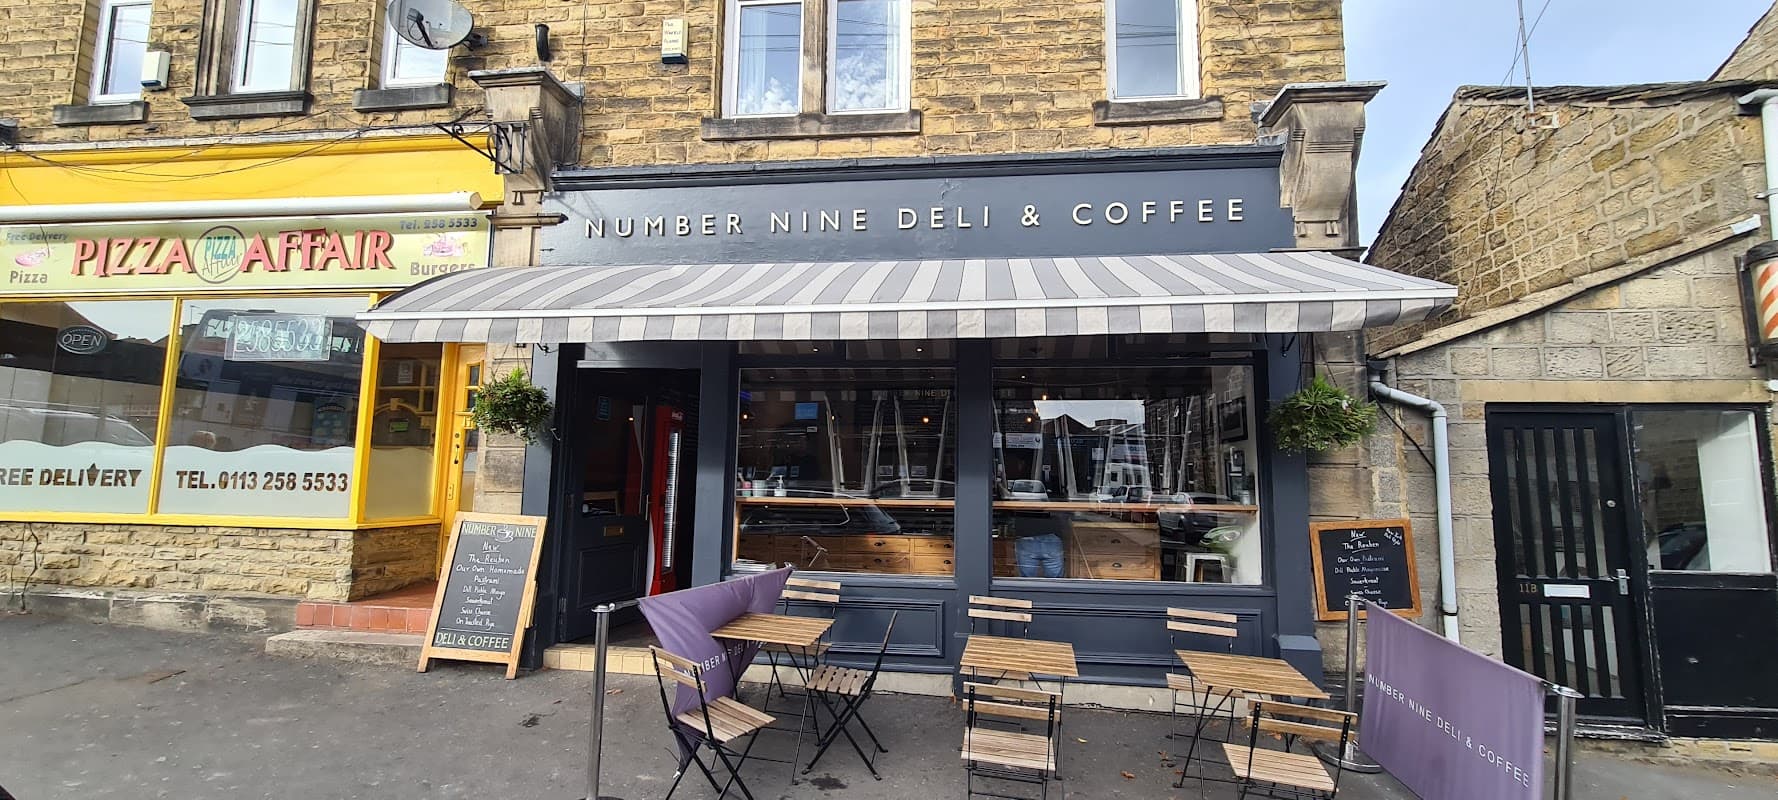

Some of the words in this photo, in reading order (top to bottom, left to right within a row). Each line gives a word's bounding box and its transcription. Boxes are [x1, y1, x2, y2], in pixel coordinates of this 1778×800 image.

[400, 220, 420, 230] Tel.
[424, 219, 446, 229] 258
[448, 217, 478, 228] 5533
[584, 213, 743, 238] NUMBER
[769, 208, 868, 233] NINE
[898, 205, 990, 230] DELI
[1020, 203, 1041, 228] &
[1071, 198, 1245, 226] COFFEE
[6, 232, 26, 241] Free
[29, 231, 68, 242] Delivery
[71, 236, 196, 277] PIZZA
[239, 227, 397, 272] AFFAIR
[204, 236, 236, 259] PIZZA
[10, 270, 48, 284] Pizza
[62, 333, 103, 347] OPEN
[39, 464, 142, 487] DELIVERY
[262, 472, 297, 491] 258
[302, 472, 348, 492] 5533
[461, 522, 497, 536] NUMBER
[515, 527, 537, 538] NINE
[1350, 530, 1366, 538] New
[482, 540, 500, 551] New
[1342, 542, 1354, 550] The
[468, 553, 480, 563] The
[485, 553, 510, 564] Reuben
[456, 564, 471, 572] Our
[435, 632, 456, 645] DELI
[457, 634, 466, 646] &
[468, 635, 509, 649] COFFEE
[1368, 673, 1405, 704] NUMBER
[1408, 698, 1432, 721] NINE
[1437, 716, 1461, 741] DELI
[1465, 736, 1473, 749] &
[1478, 744, 1529, 788] COFFEE
